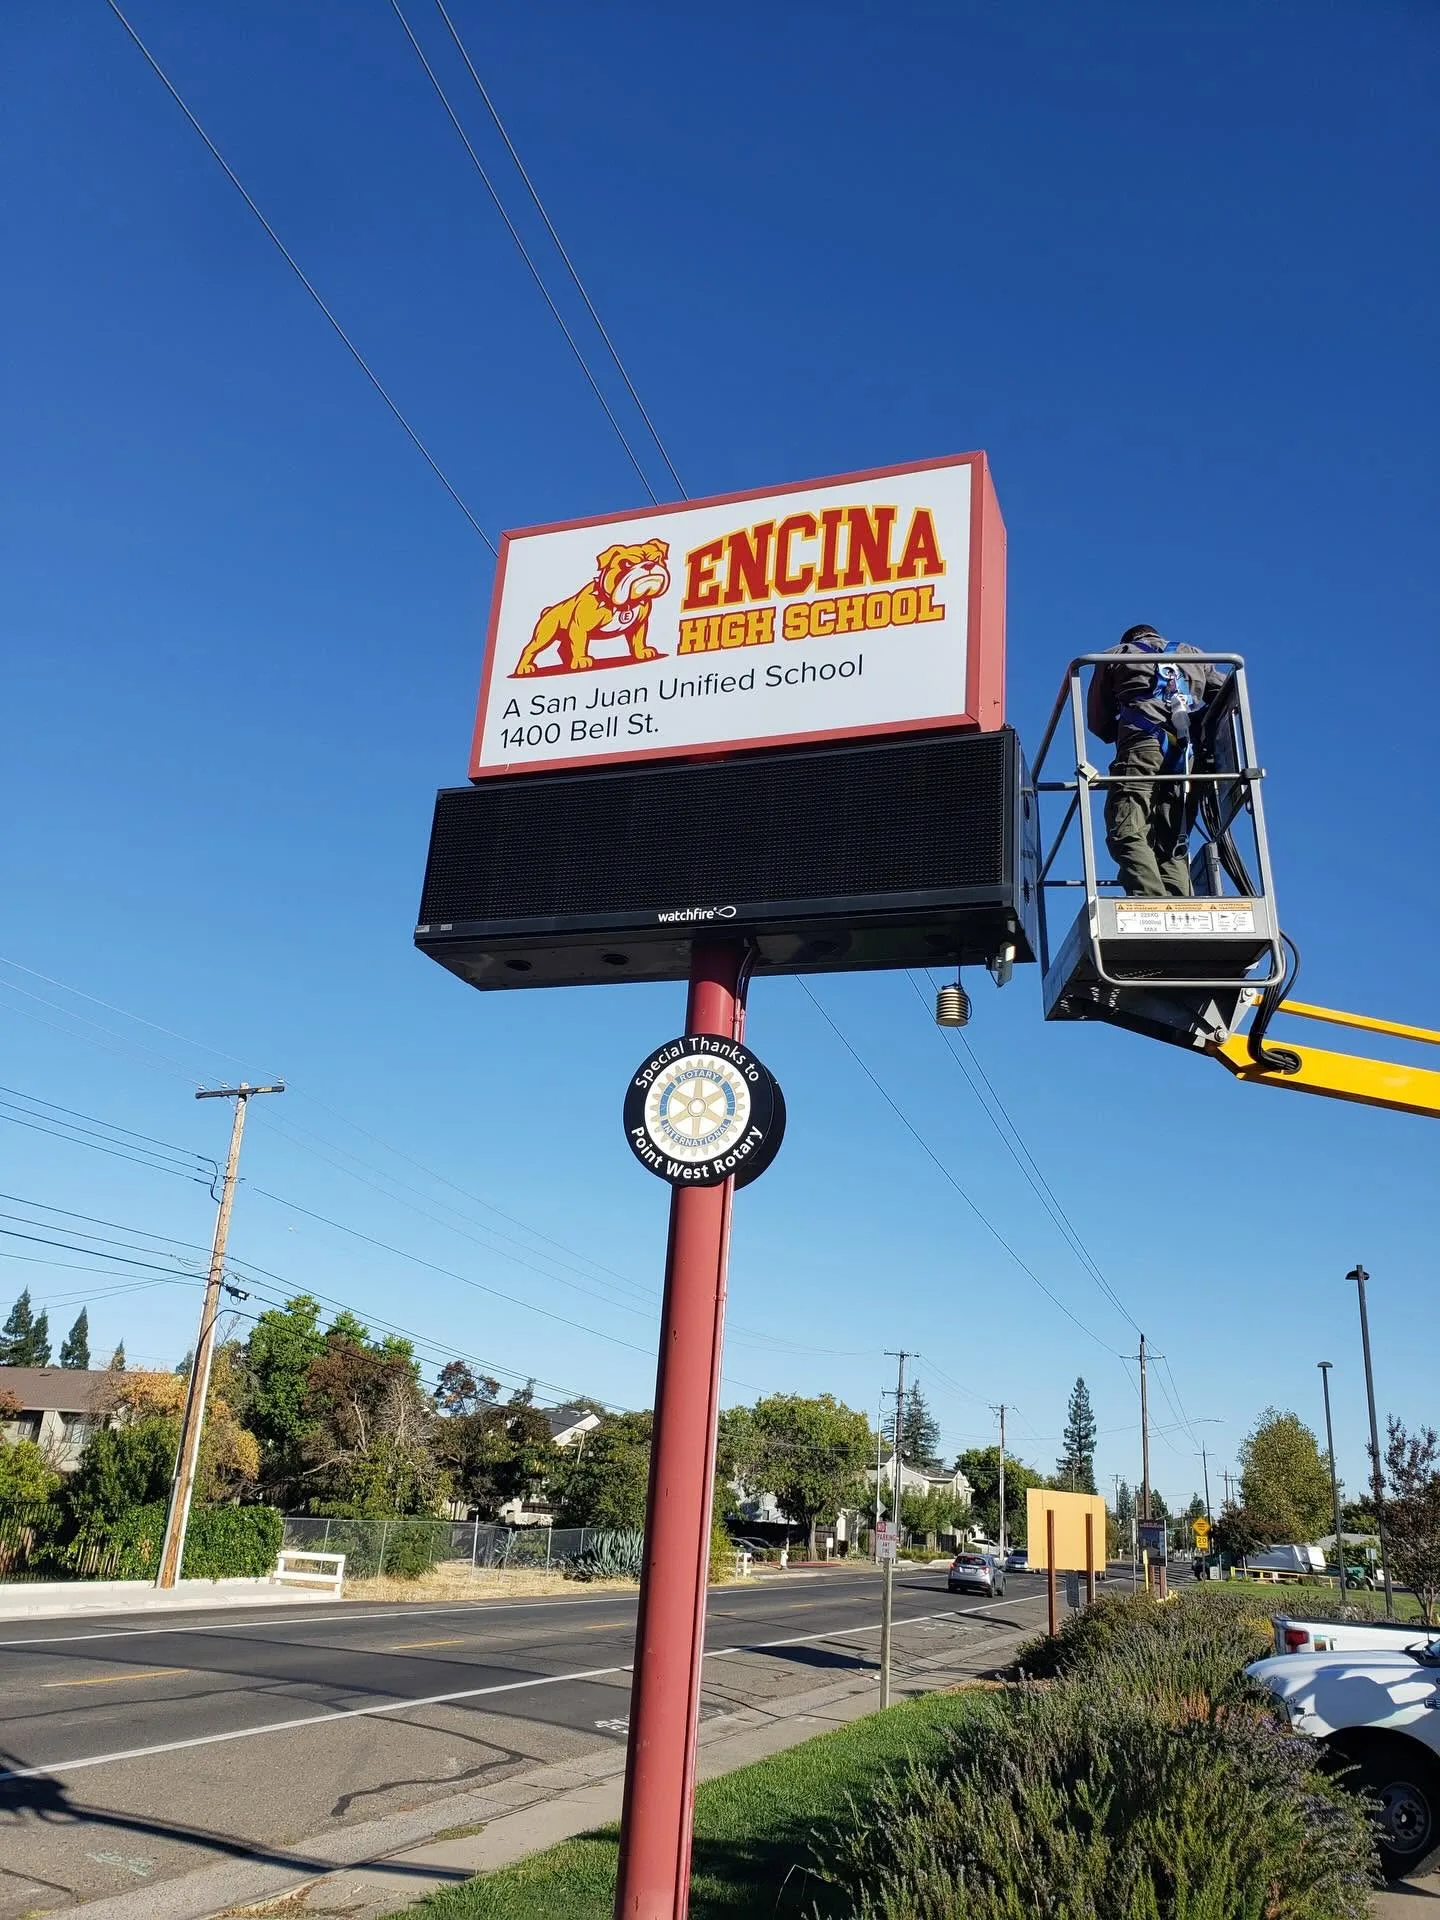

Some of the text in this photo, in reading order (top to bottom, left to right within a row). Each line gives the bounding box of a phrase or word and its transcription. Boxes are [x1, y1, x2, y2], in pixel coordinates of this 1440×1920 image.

[681, 505, 946, 612] ENCINA
[624, 612, 631, 620] E
[677, 584, 946, 656] HIGH SCHOOL
[502, 654, 863, 719] A San Juan Unified School
[500, 713, 659, 749] 1400 Bell St.
[658, 908, 714, 922] watchfire
[636, 1036, 759, 1088] Special Thanks to
[680, 1071, 719, 1081] ROTARY
[632, 1126, 762, 1179] Point West Rotary
[663, 1120, 730, 1146] INTERNATIONAL
